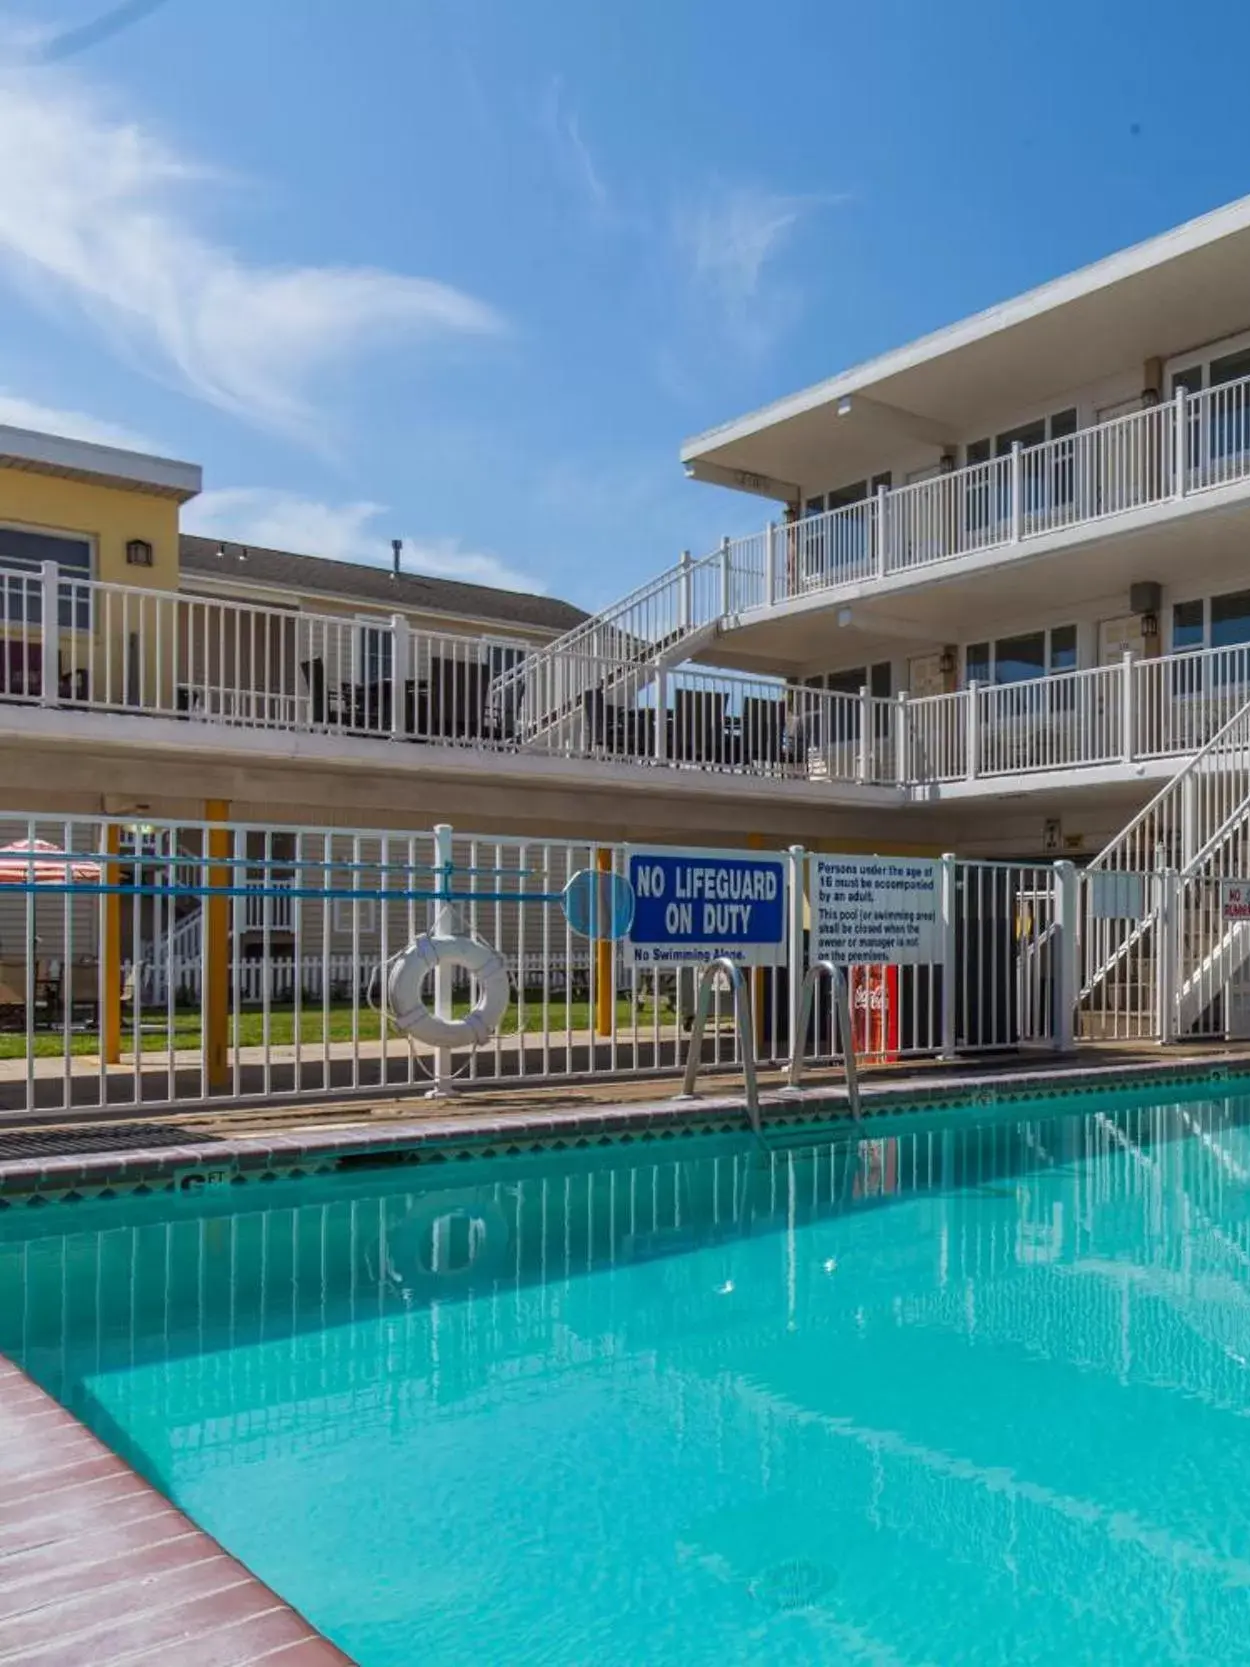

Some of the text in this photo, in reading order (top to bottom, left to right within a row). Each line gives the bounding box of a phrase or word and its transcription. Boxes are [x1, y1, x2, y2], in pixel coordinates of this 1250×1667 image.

[818, 862, 934, 879] Persons under the age of
[637, 865, 777, 900] NO LIFEGUARD
[835, 878, 859, 889] must
[861, 879, 873, 889] be
[874, 879, 935, 892] accompanied
[819, 890, 875, 903] by an adult.
[665, 902, 752, 934] ON DUTY
[818, 908, 838, 920] This
[840, 909, 858, 922] pool
[874, 911, 914, 922] swimming
[819, 922, 920, 935] shall be closed when the
[818, 938, 846, 948] owner
[848, 938, 857, 948] or
[859, 938, 895, 950] manager
[634, 949, 649, 961] No
[653, 949, 710, 962] Swimming
[831, 950, 845, 961] the
